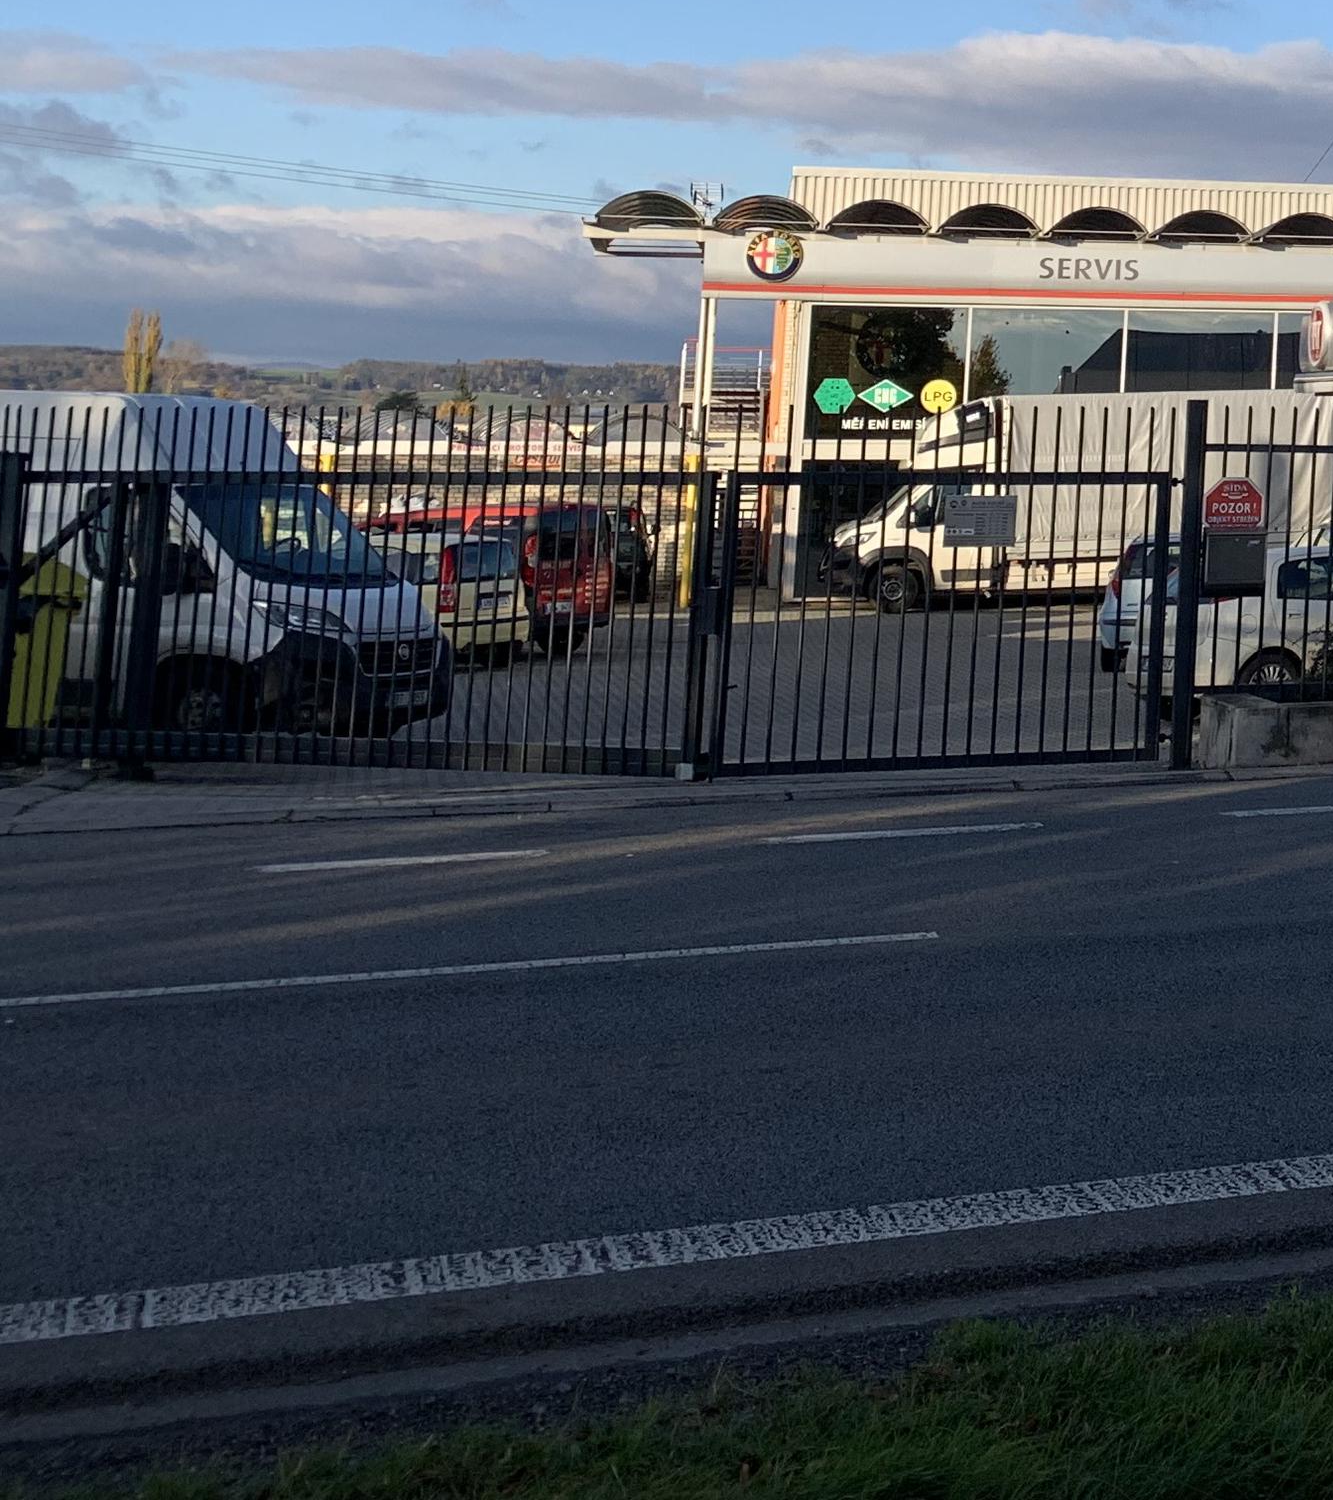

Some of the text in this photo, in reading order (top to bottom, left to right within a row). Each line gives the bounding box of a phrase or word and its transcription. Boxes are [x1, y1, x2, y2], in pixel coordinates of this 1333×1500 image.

[1039, 257, 1139, 281] SERVIS
[873, 388, 897, 404] CNG
[924, 391, 953, 403] LPG
